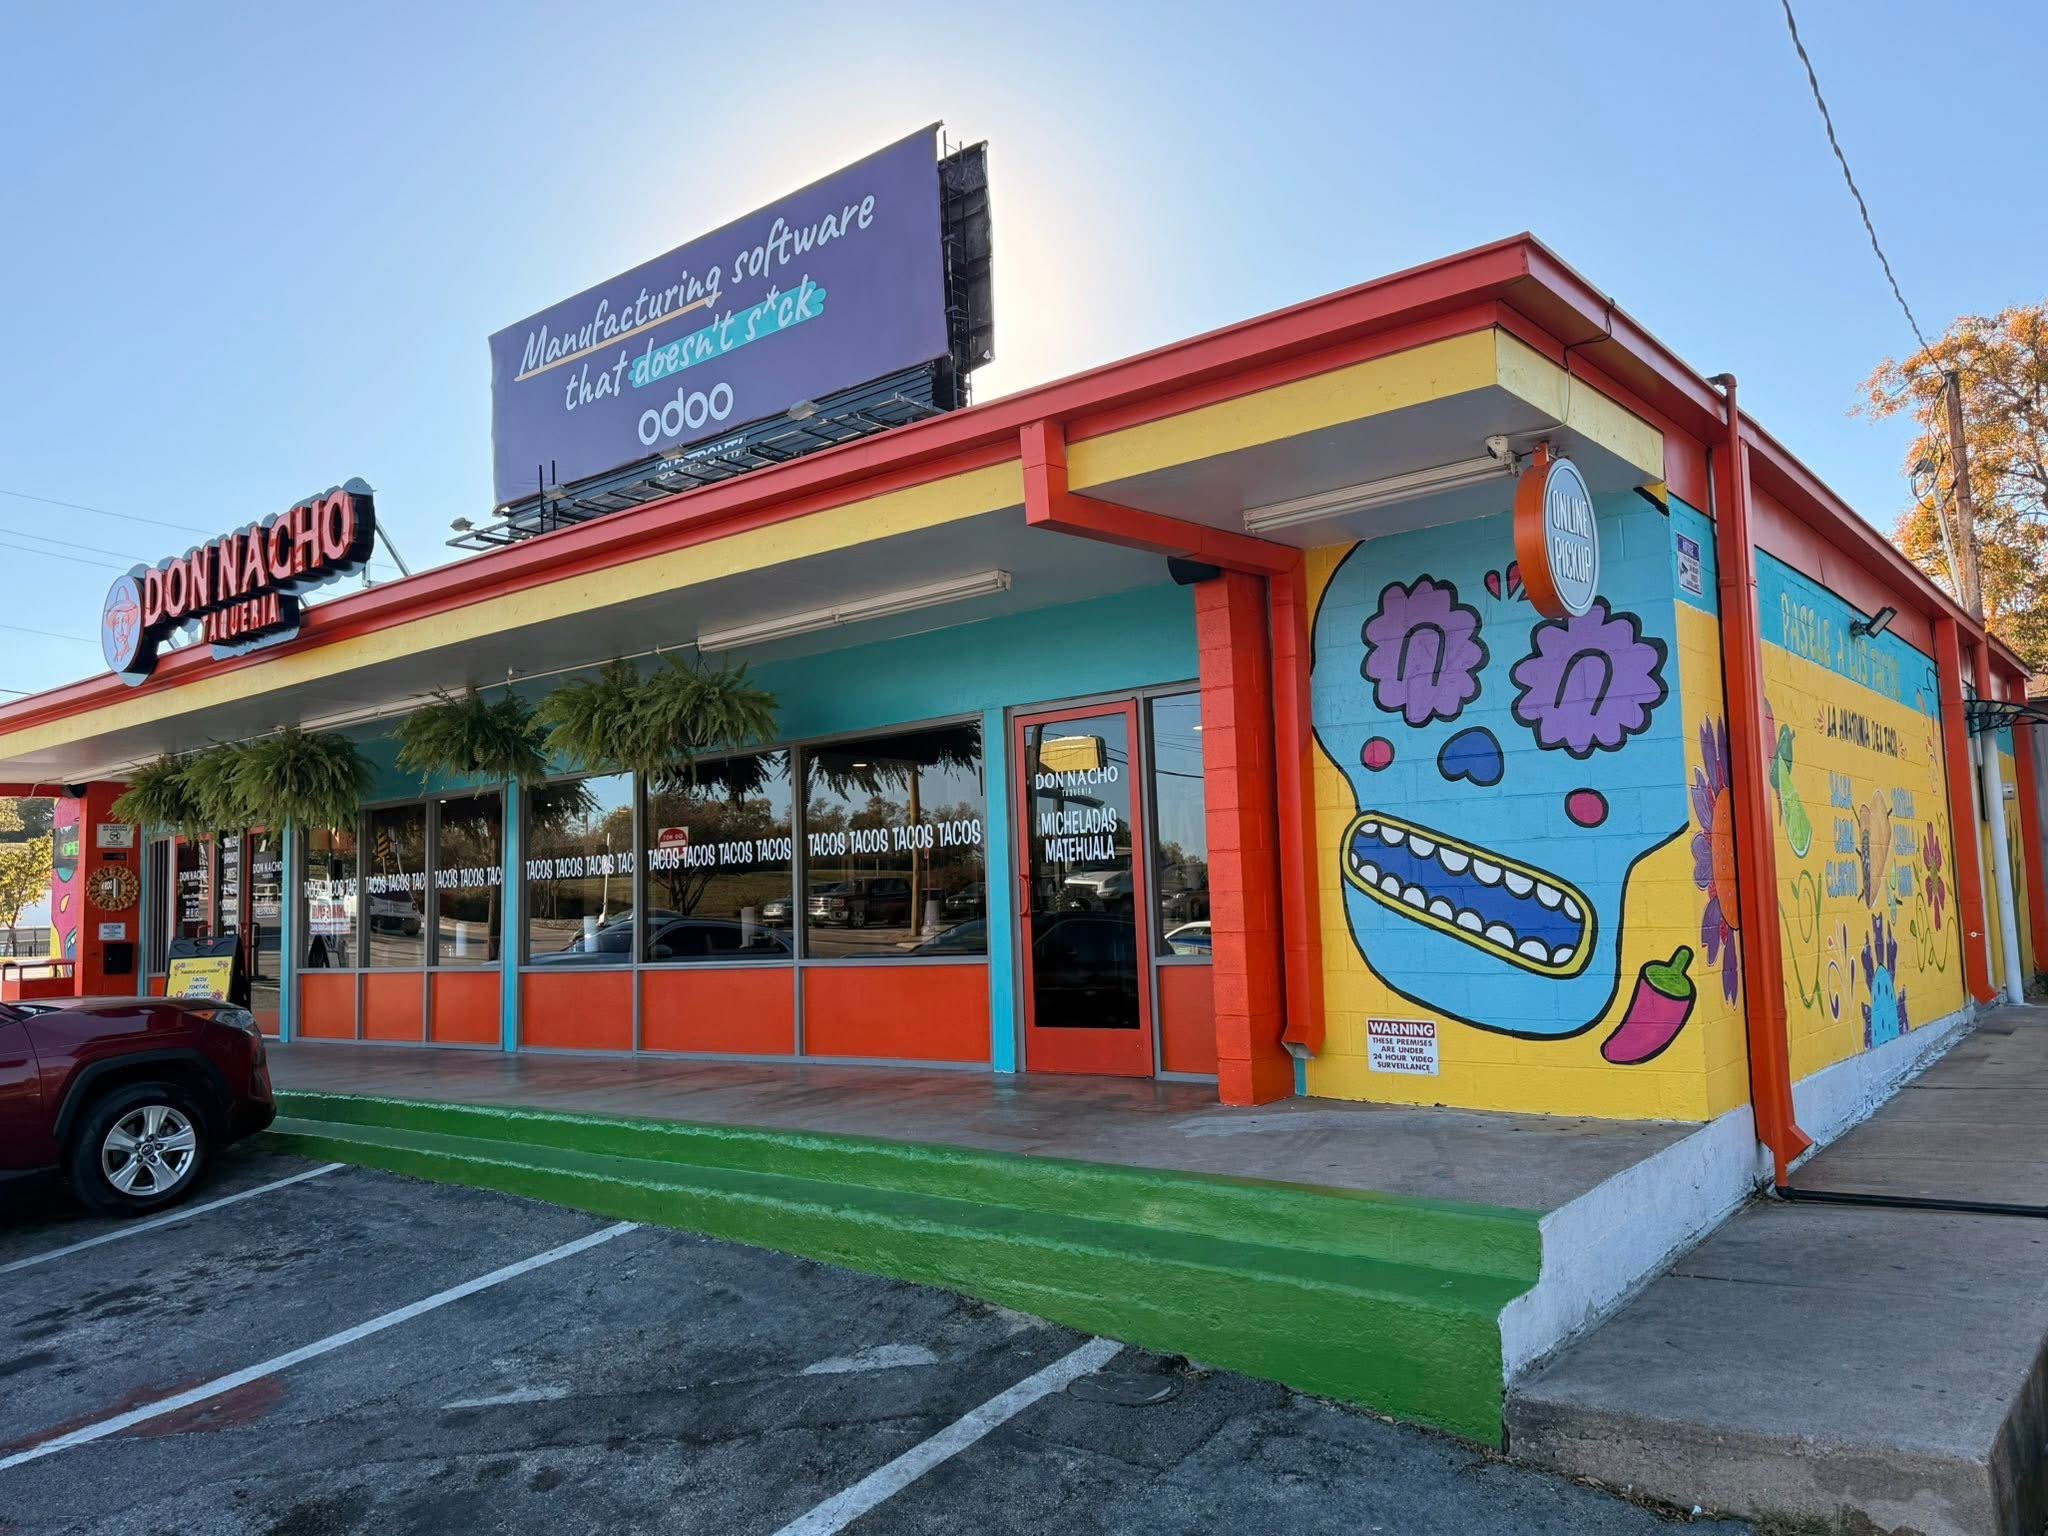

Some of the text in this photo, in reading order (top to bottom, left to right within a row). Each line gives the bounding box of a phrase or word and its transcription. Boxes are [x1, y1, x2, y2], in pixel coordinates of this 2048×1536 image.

[519, 194, 876, 376] Manufacturing software
[565, 351, 627, 411] that
[634, 312, 734, 388] doesn't
[638, 382, 735, 446] odoo
[1552, 490, 1589, 539] ONLINE
[144, 489, 355, 628] DON NACHO
[1554, 537, 1592, 583] PICKUP
[202, 592, 281, 643] TAQUERIA
[1827, 704, 1837, 737] LA
[1872, 720, 1883, 753] DEL
[1035, 765, 1119, 790] DON NACHO
[808, 818, 981, 857] TACOS TACOS TACOS TACOS
[1041, 807, 1118, 837] MICHELADAS
[648, 837, 792, 871] TACOS TACOS TACOS TACOS
[1045, 834, 1116, 863] MATEHUALA
[253, 863, 264, 874] DON
[435, 869, 458, 889] TACOS
[460, 868, 484, 887] TACOS
[526, 859, 553, 880] TACOS
[555, 856, 583, 878] TACOS
[585, 853, 614, 876] TACOS
[365, 876, 386, 894] TACOS
[388, 873, 410, 892] TACOS
[1369, 1021, 1434, 1036] WARNING
[1372, 1037, 1433, 1047] THESE PREMISES
[1377, 1061, 1431, 1071] SURVEILLANCE
